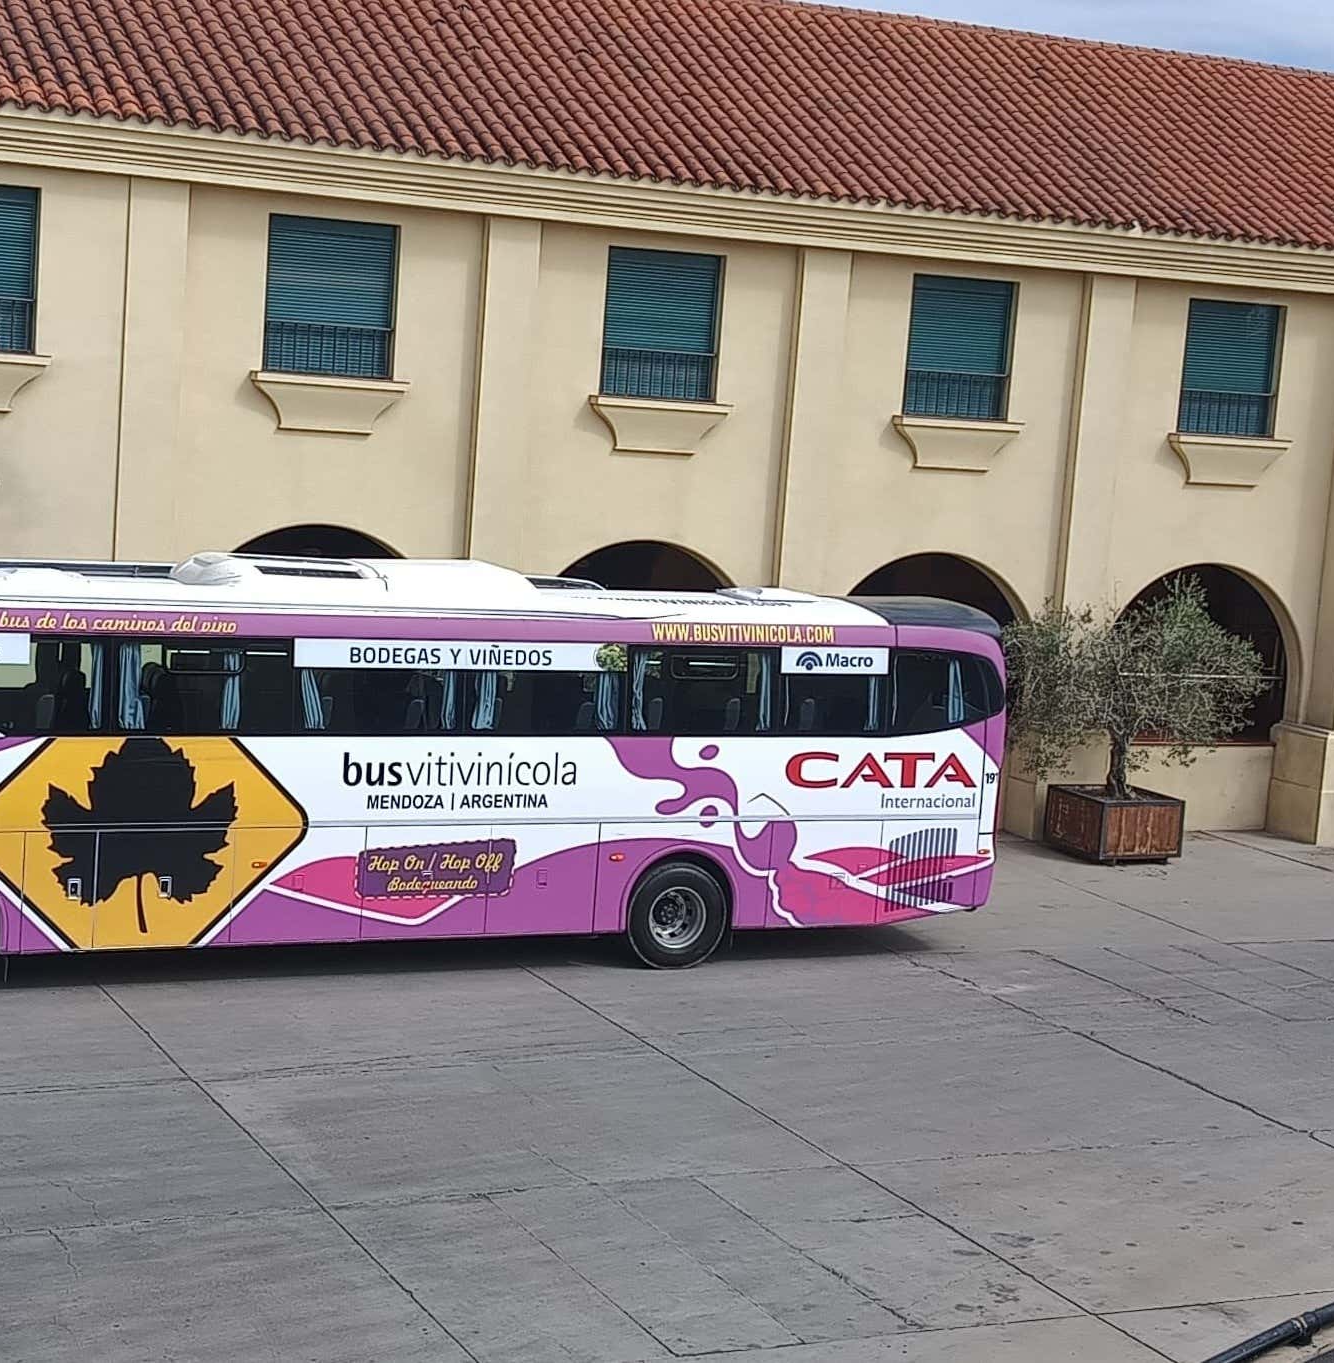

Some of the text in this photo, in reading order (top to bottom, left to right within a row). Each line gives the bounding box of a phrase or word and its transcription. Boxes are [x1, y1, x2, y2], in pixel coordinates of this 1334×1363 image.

[0, 610, 30, 629] bus
[34, 612, 57, 630] de
[60, 612, 87, 631] los
[92, 613, 165, 633] caminos
[170, 615, 196, 633] del
[197, 616, 237, 634] vino
[651, 622, 835, 644] WWW.BUSVITIVINICOLA.COM
[349, 644, 553, 666] BODEGAS Y VIÑEDOS
[825, 652, 874, 668] Macro
[342, 751, 578, 787] busvitivinícola
[785, 751, 977, 789] CATA
[366, 794, 445, 810] MENDOZA
[459, 793, 549, 809] ARGENTINA
[880, 792, 976, 809] Internacional
[367, 855, 401, 876] Hop
[403, 854, 425, 871] On
[439, 853, 471, 874] Hop
[475, 851, 504, 873] Off
[386, 875, 479, 895] Bodegueando
